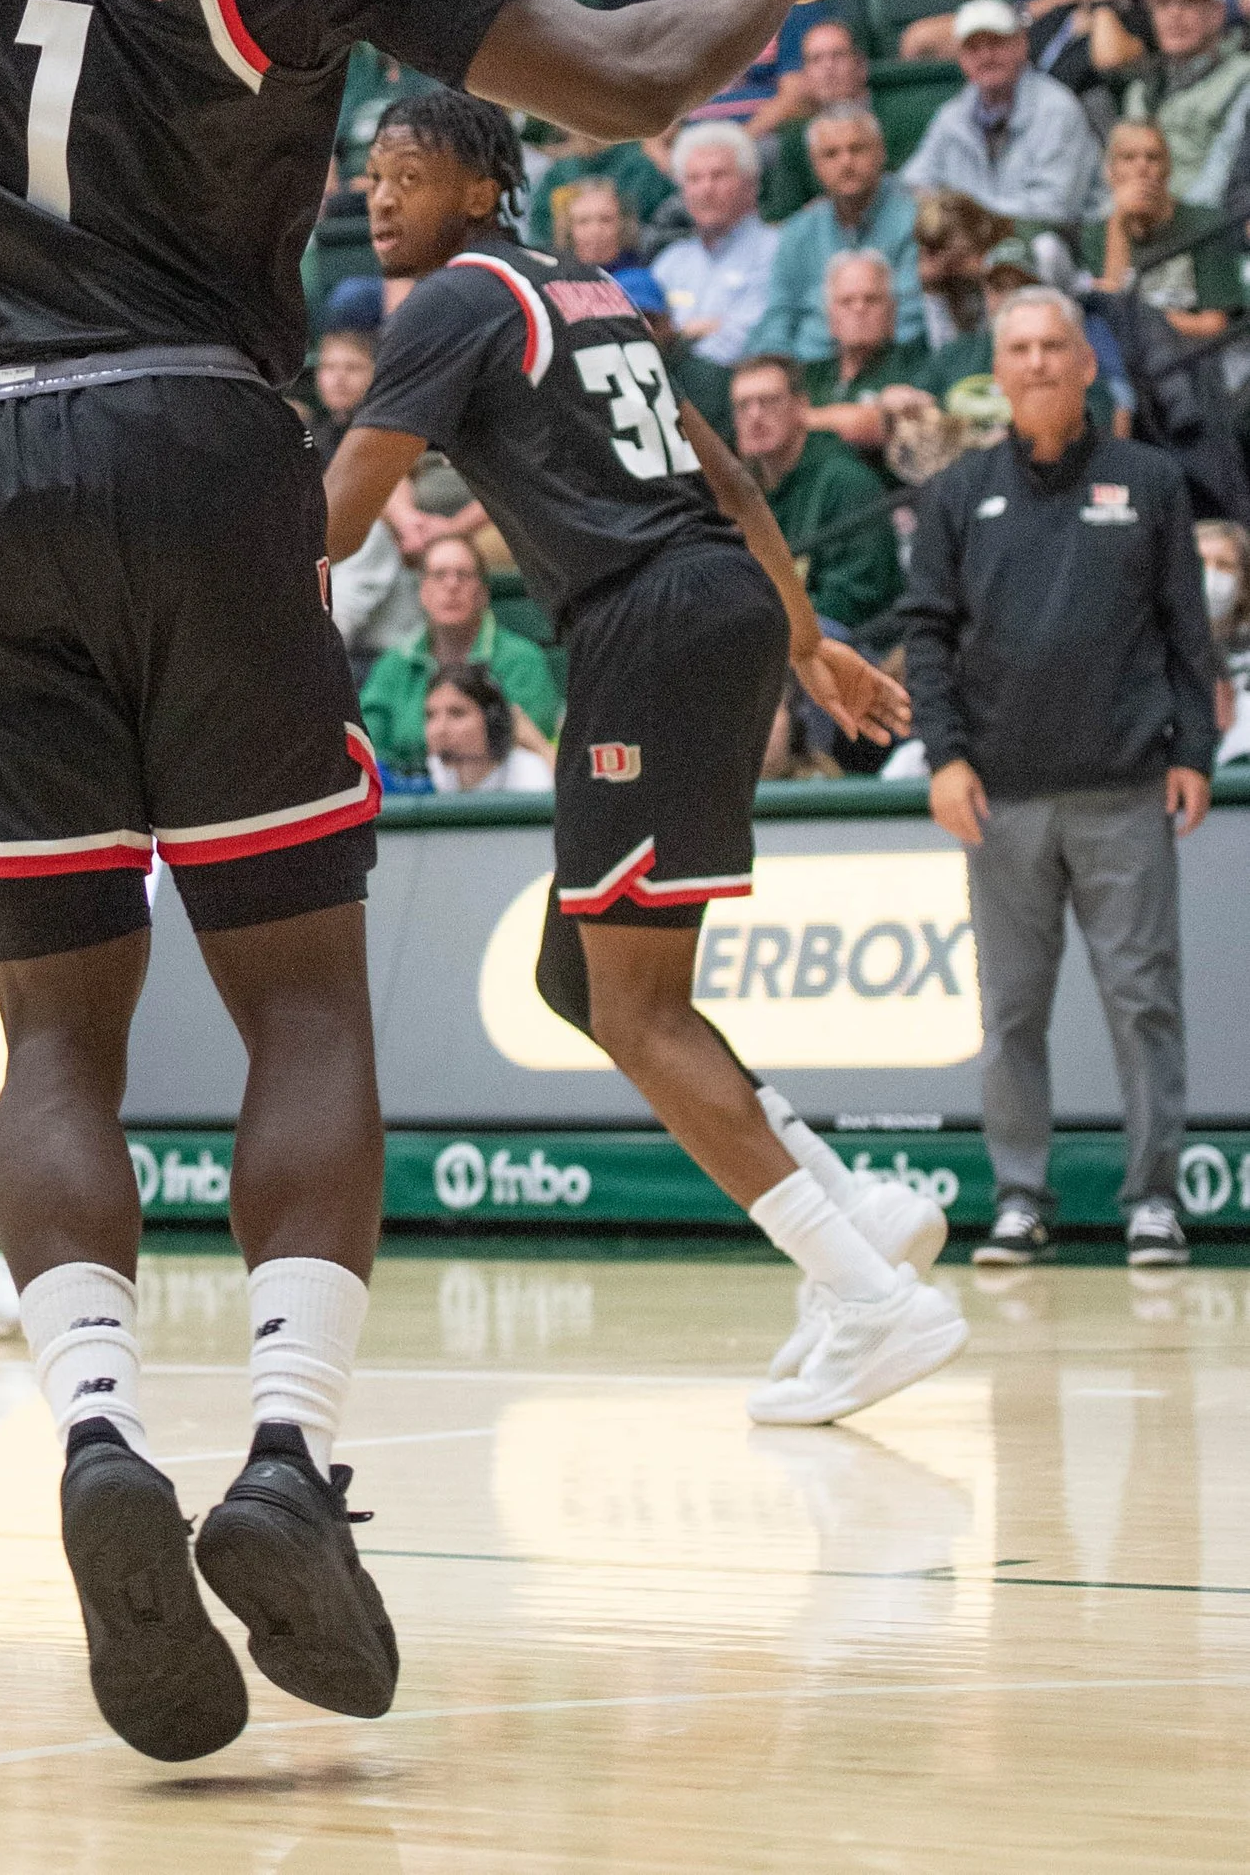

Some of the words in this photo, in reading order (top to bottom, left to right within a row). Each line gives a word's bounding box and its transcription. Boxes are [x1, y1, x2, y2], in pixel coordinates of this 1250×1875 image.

[573, 340, 700, 480] 32
[161, 1148, 231, 1204] fnb
[488, 1149, 592, 1206] fnbo
